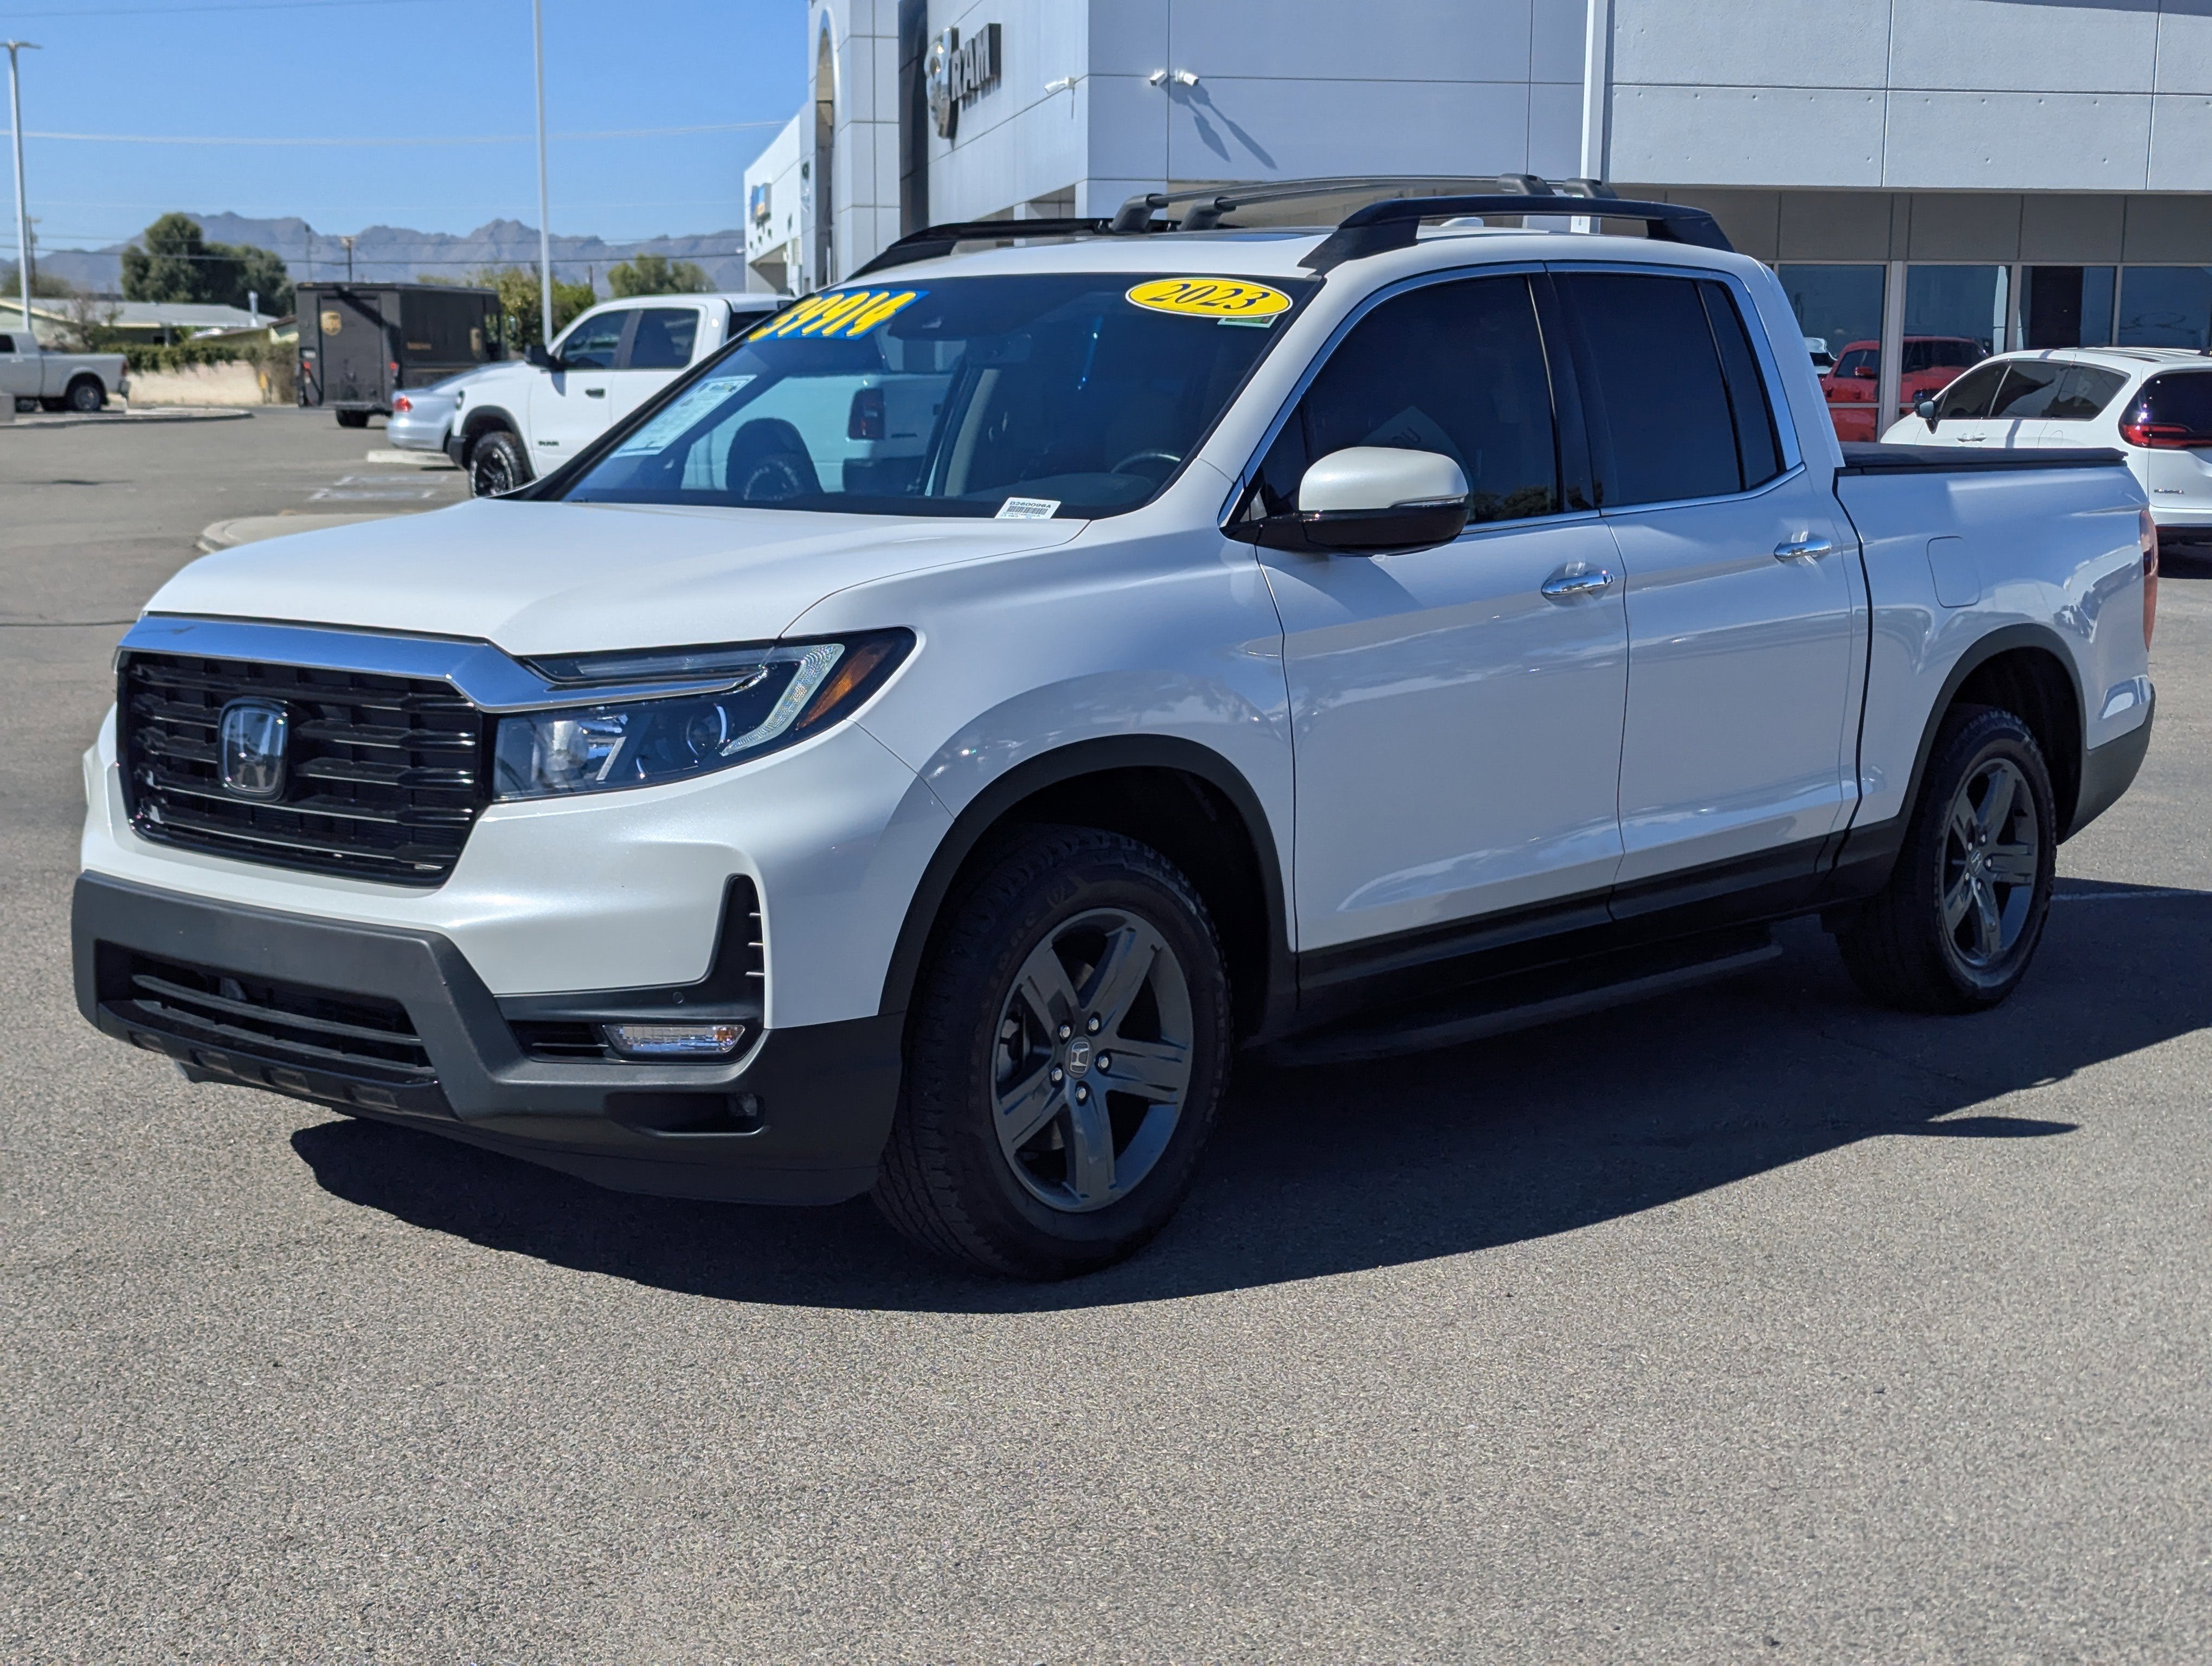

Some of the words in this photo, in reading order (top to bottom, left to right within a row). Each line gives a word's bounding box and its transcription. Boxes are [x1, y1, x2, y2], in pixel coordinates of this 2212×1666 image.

[951, 23, 1001, 101] RAM
[748, 292, 916, 342] 39914
[1144, 283, 1271, 309] 2023
